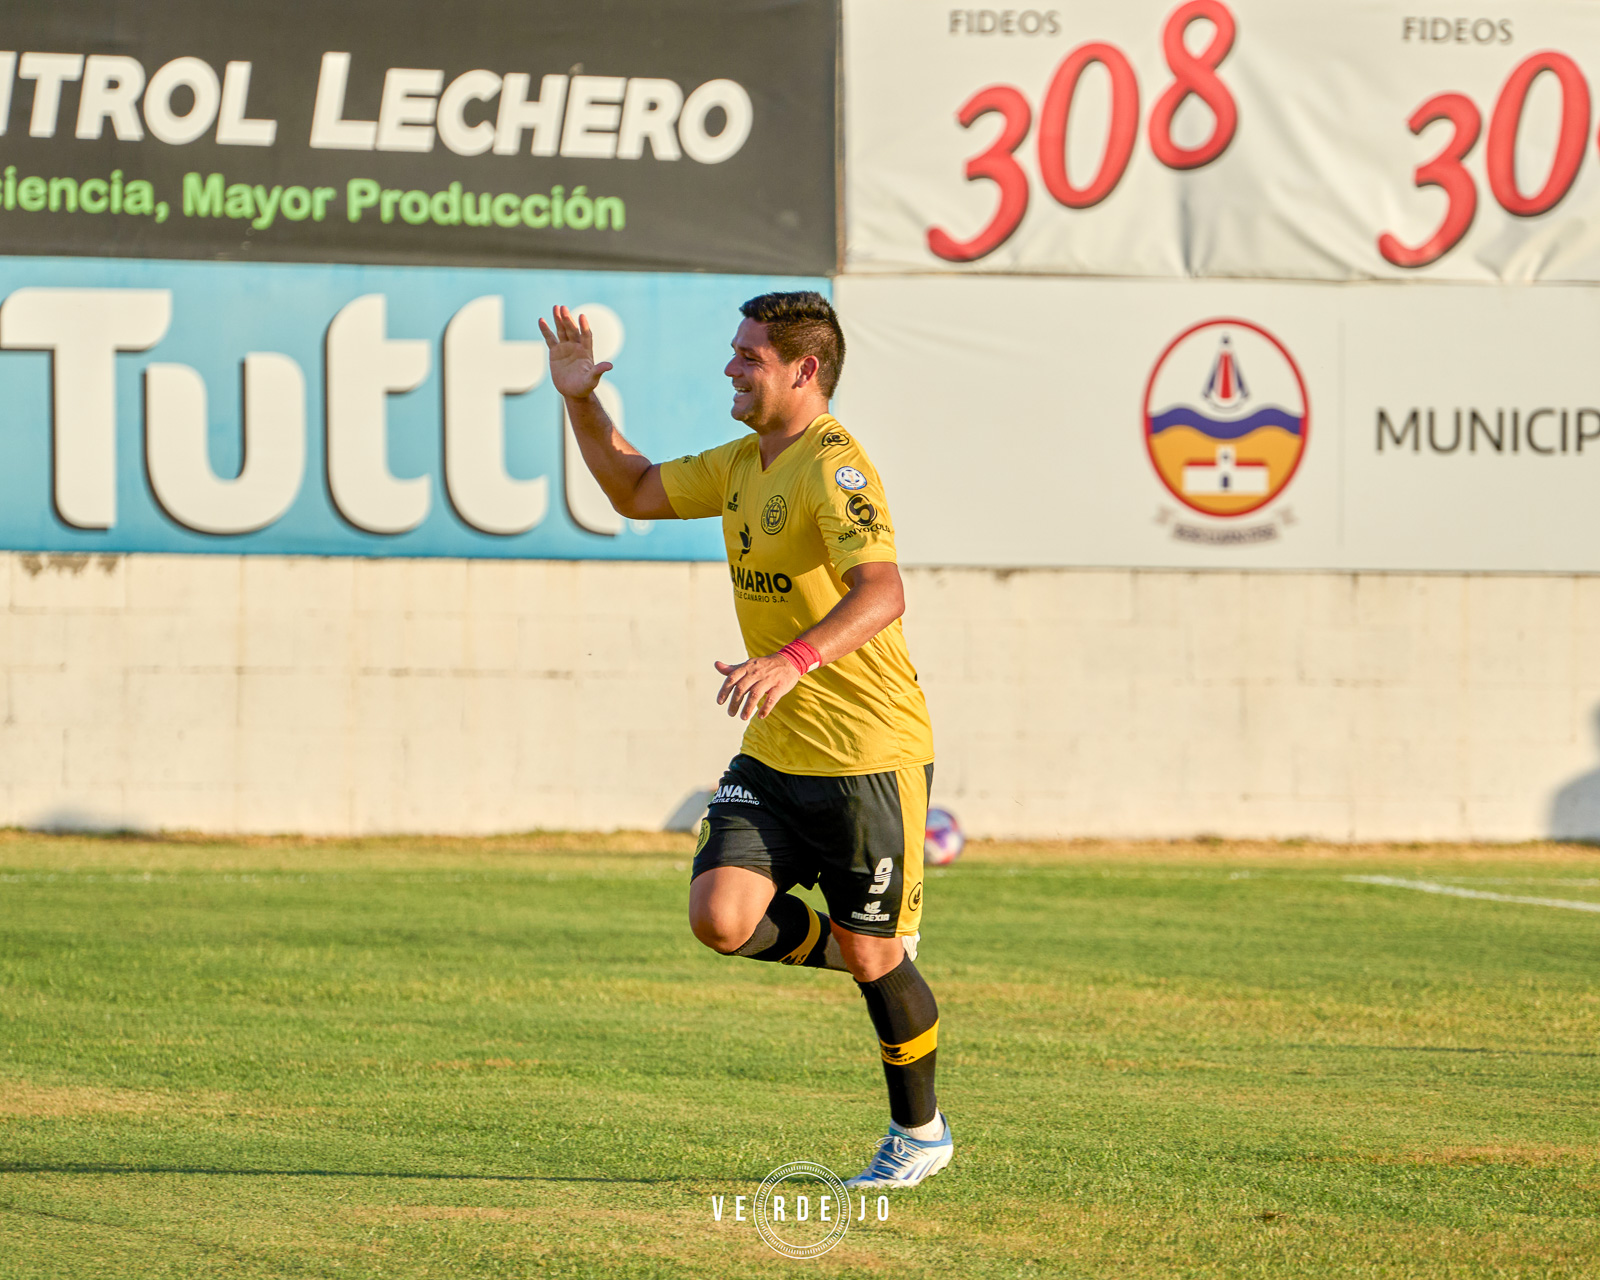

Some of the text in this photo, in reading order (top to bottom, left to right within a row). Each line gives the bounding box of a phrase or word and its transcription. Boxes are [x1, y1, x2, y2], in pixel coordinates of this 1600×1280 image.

[948, 9, 1062, 37] FIDEOS
[1402, 16, 1514, 45] FIDEOS
[309, 51, 754, 165] LECHERO
[926, 0, 1240, 263] 308
[1377, 49, 1600, 268] 30
[0, 165, 627, 232] iencia, Mayor Producción
[1375, 406, 1600, 455] MUNICIP
[868, 857, 894, 894] 9
